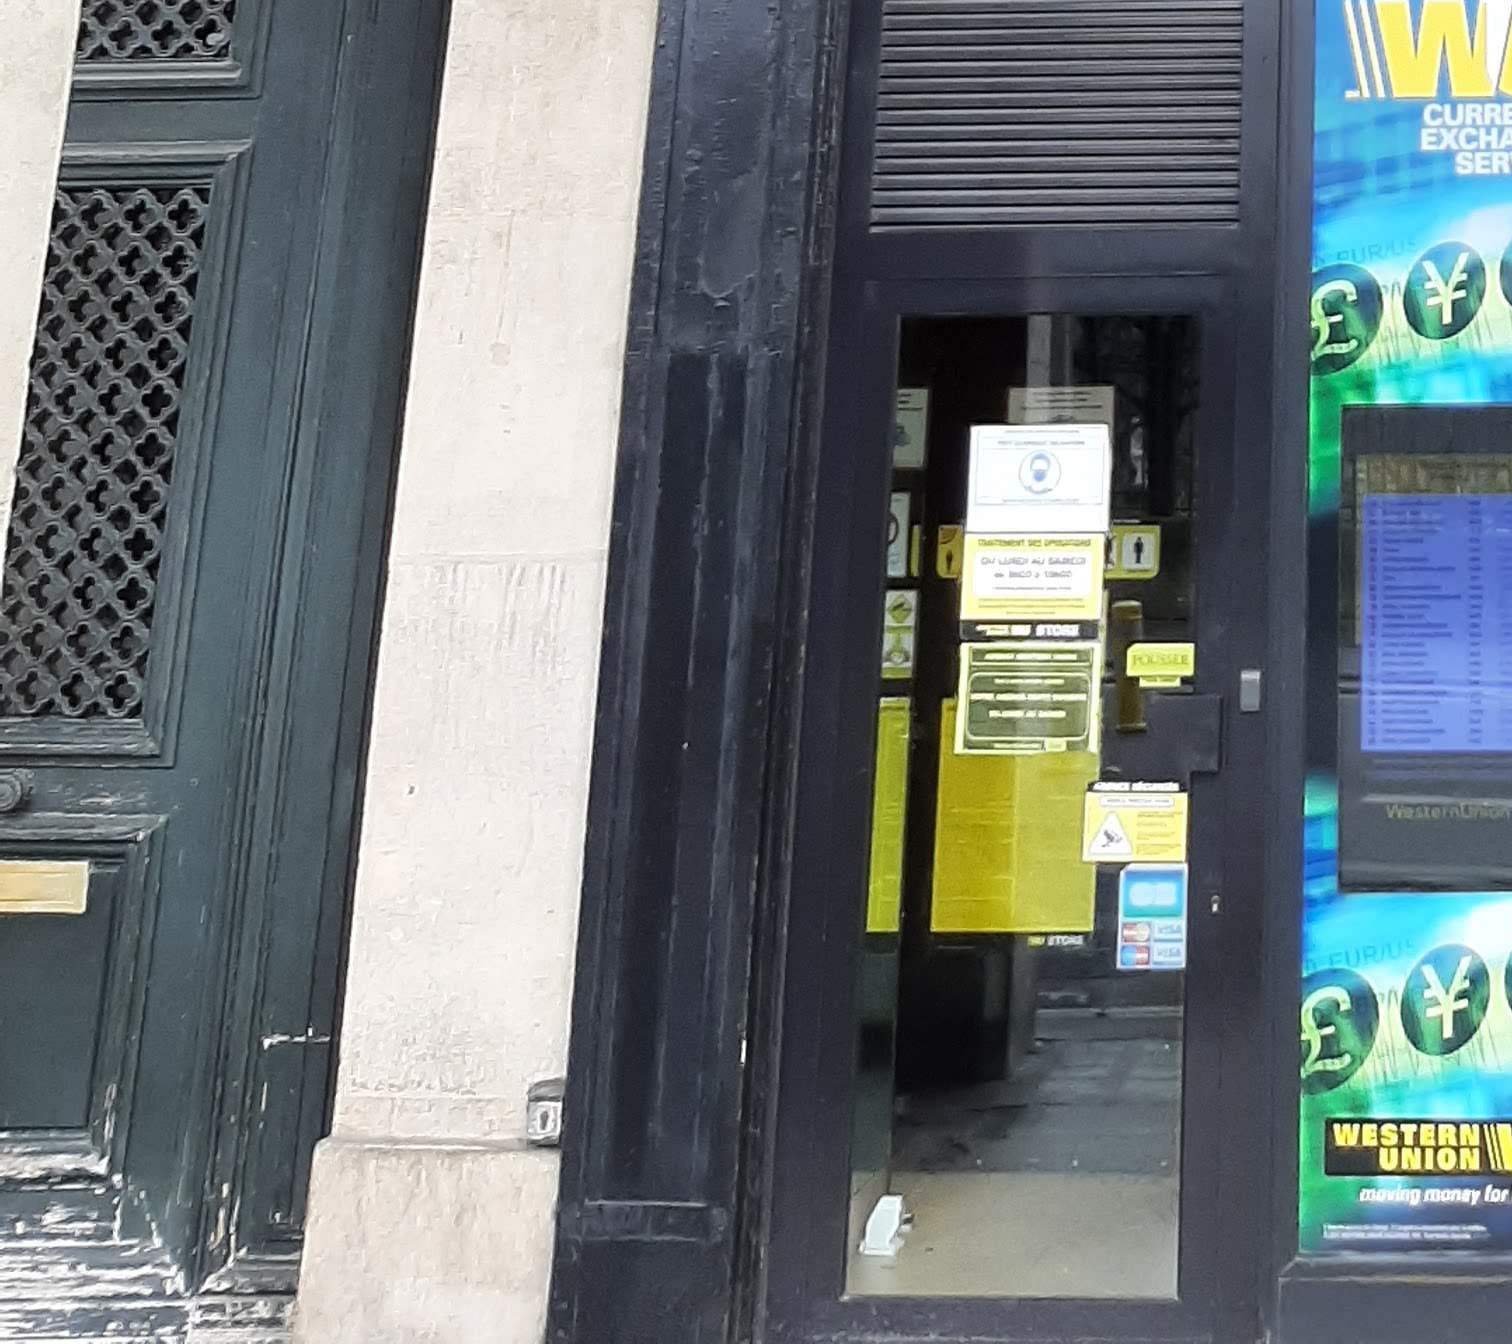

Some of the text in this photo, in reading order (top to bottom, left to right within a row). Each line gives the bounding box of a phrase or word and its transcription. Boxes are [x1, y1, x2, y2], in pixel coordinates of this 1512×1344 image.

[1333, 1123, 1480, 1146] WESTERN
[1379, 1147, 1480, 1171] UNION
[1359, 1185, 1421, 1205] moving
[1423, 1188, 1481, 1204] money
[1484, 1184, 1509, 1202] for
